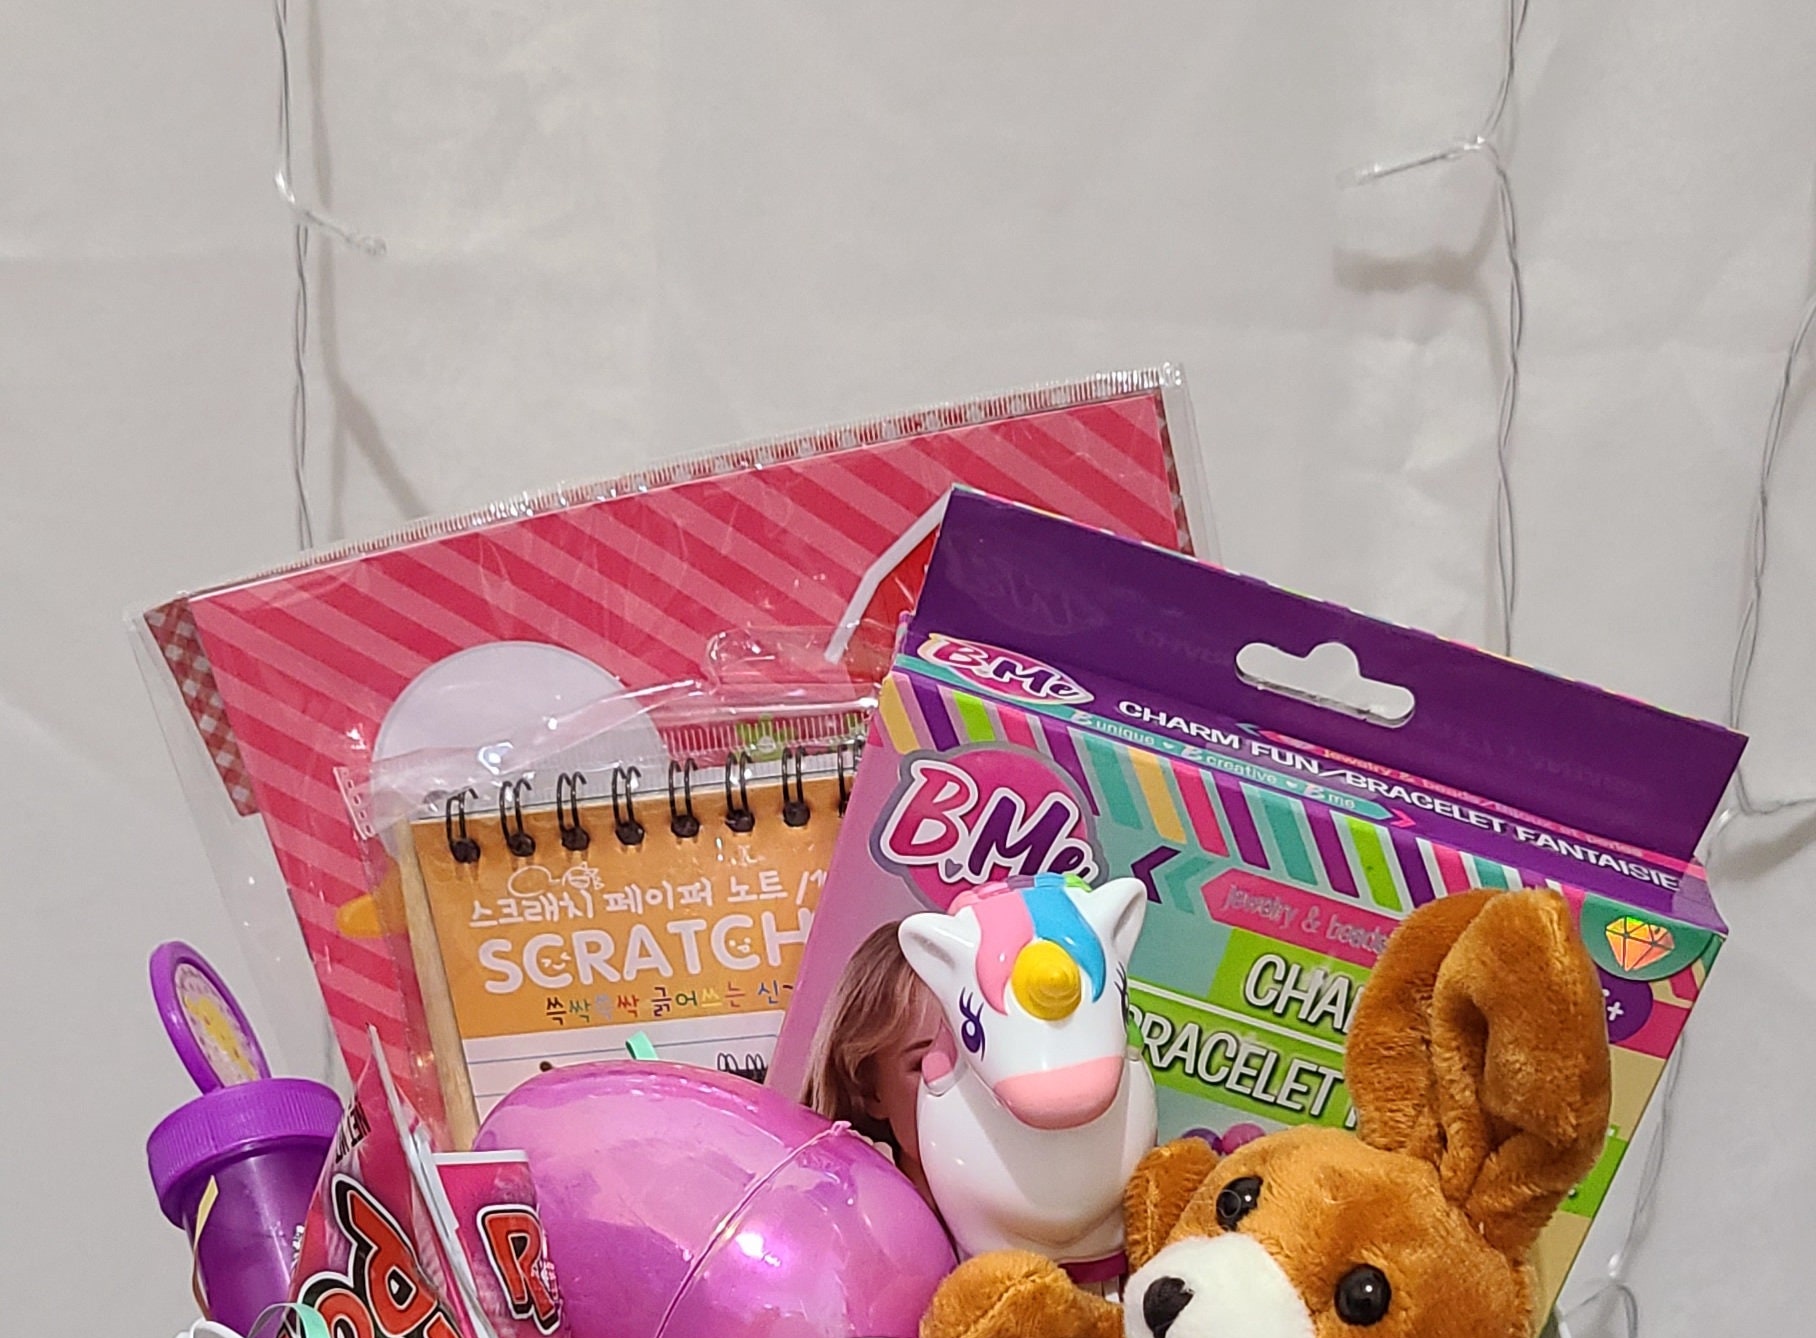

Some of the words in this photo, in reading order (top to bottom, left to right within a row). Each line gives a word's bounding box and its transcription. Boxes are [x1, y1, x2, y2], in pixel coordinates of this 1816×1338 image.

[1095, 719, 1155, 745] unique
[1206, 754, 1278, 784] creative
[1328, 793, 1356, 810] me
[1118, 700, 1242, 750] CHARM
[1250, 740, 1503, 833] FUN/BRACELET
[1515, 825, 1682, 892] FANTAISIE
[469, 888, 594, 927] 스크래치
[603, 876, 713, 915] 페이퍼
[727, 869, 789, 903] 노트
[1220, 884, 1298, 930] jewelry
[1301, 905, 1321, 933] &
[478, 907, 815, 994] SCRATCH
[757, 979, 794, 1005] 신
